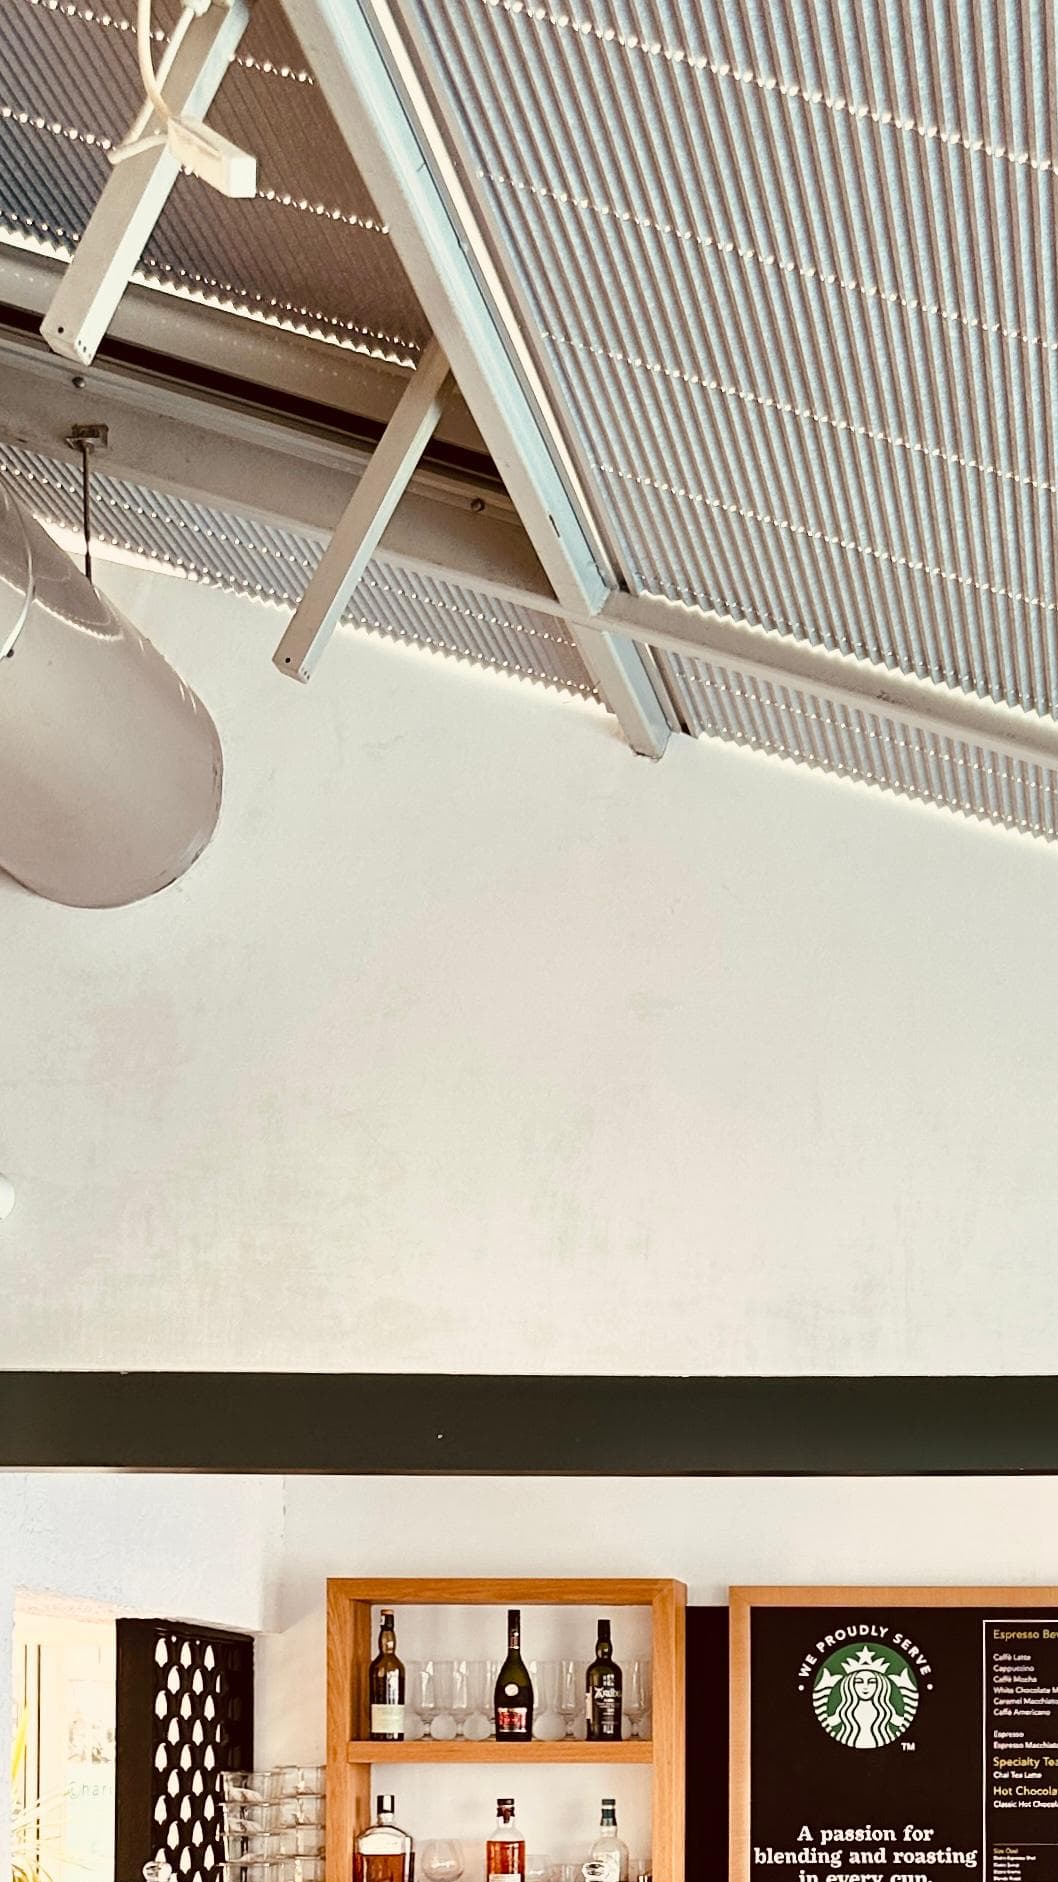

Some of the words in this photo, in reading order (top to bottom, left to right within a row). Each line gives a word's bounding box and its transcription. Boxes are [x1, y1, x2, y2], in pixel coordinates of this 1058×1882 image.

[994, 1630, 1039, 1641] Espresso
[799, 1654, 818, 1677] WE
[816, 1624, 889, 1652] PROUDLY
[892, 1633, 932, 1676] SERVE
[901, 1742, 915, 1751] TM
[993, 1757, 1040, 1769] Specialty
[994, 1786, 1012, 1796] Hot
[797, 1825, 813, 1841] A
[820, 1825, 897, 1845] passion
[903, 1825, 934, 1841] for
[754, 1848, 842, 1868] blending
[849, 1848, 887, 1864] and
[893, 1848, 977, 1868] roasting
